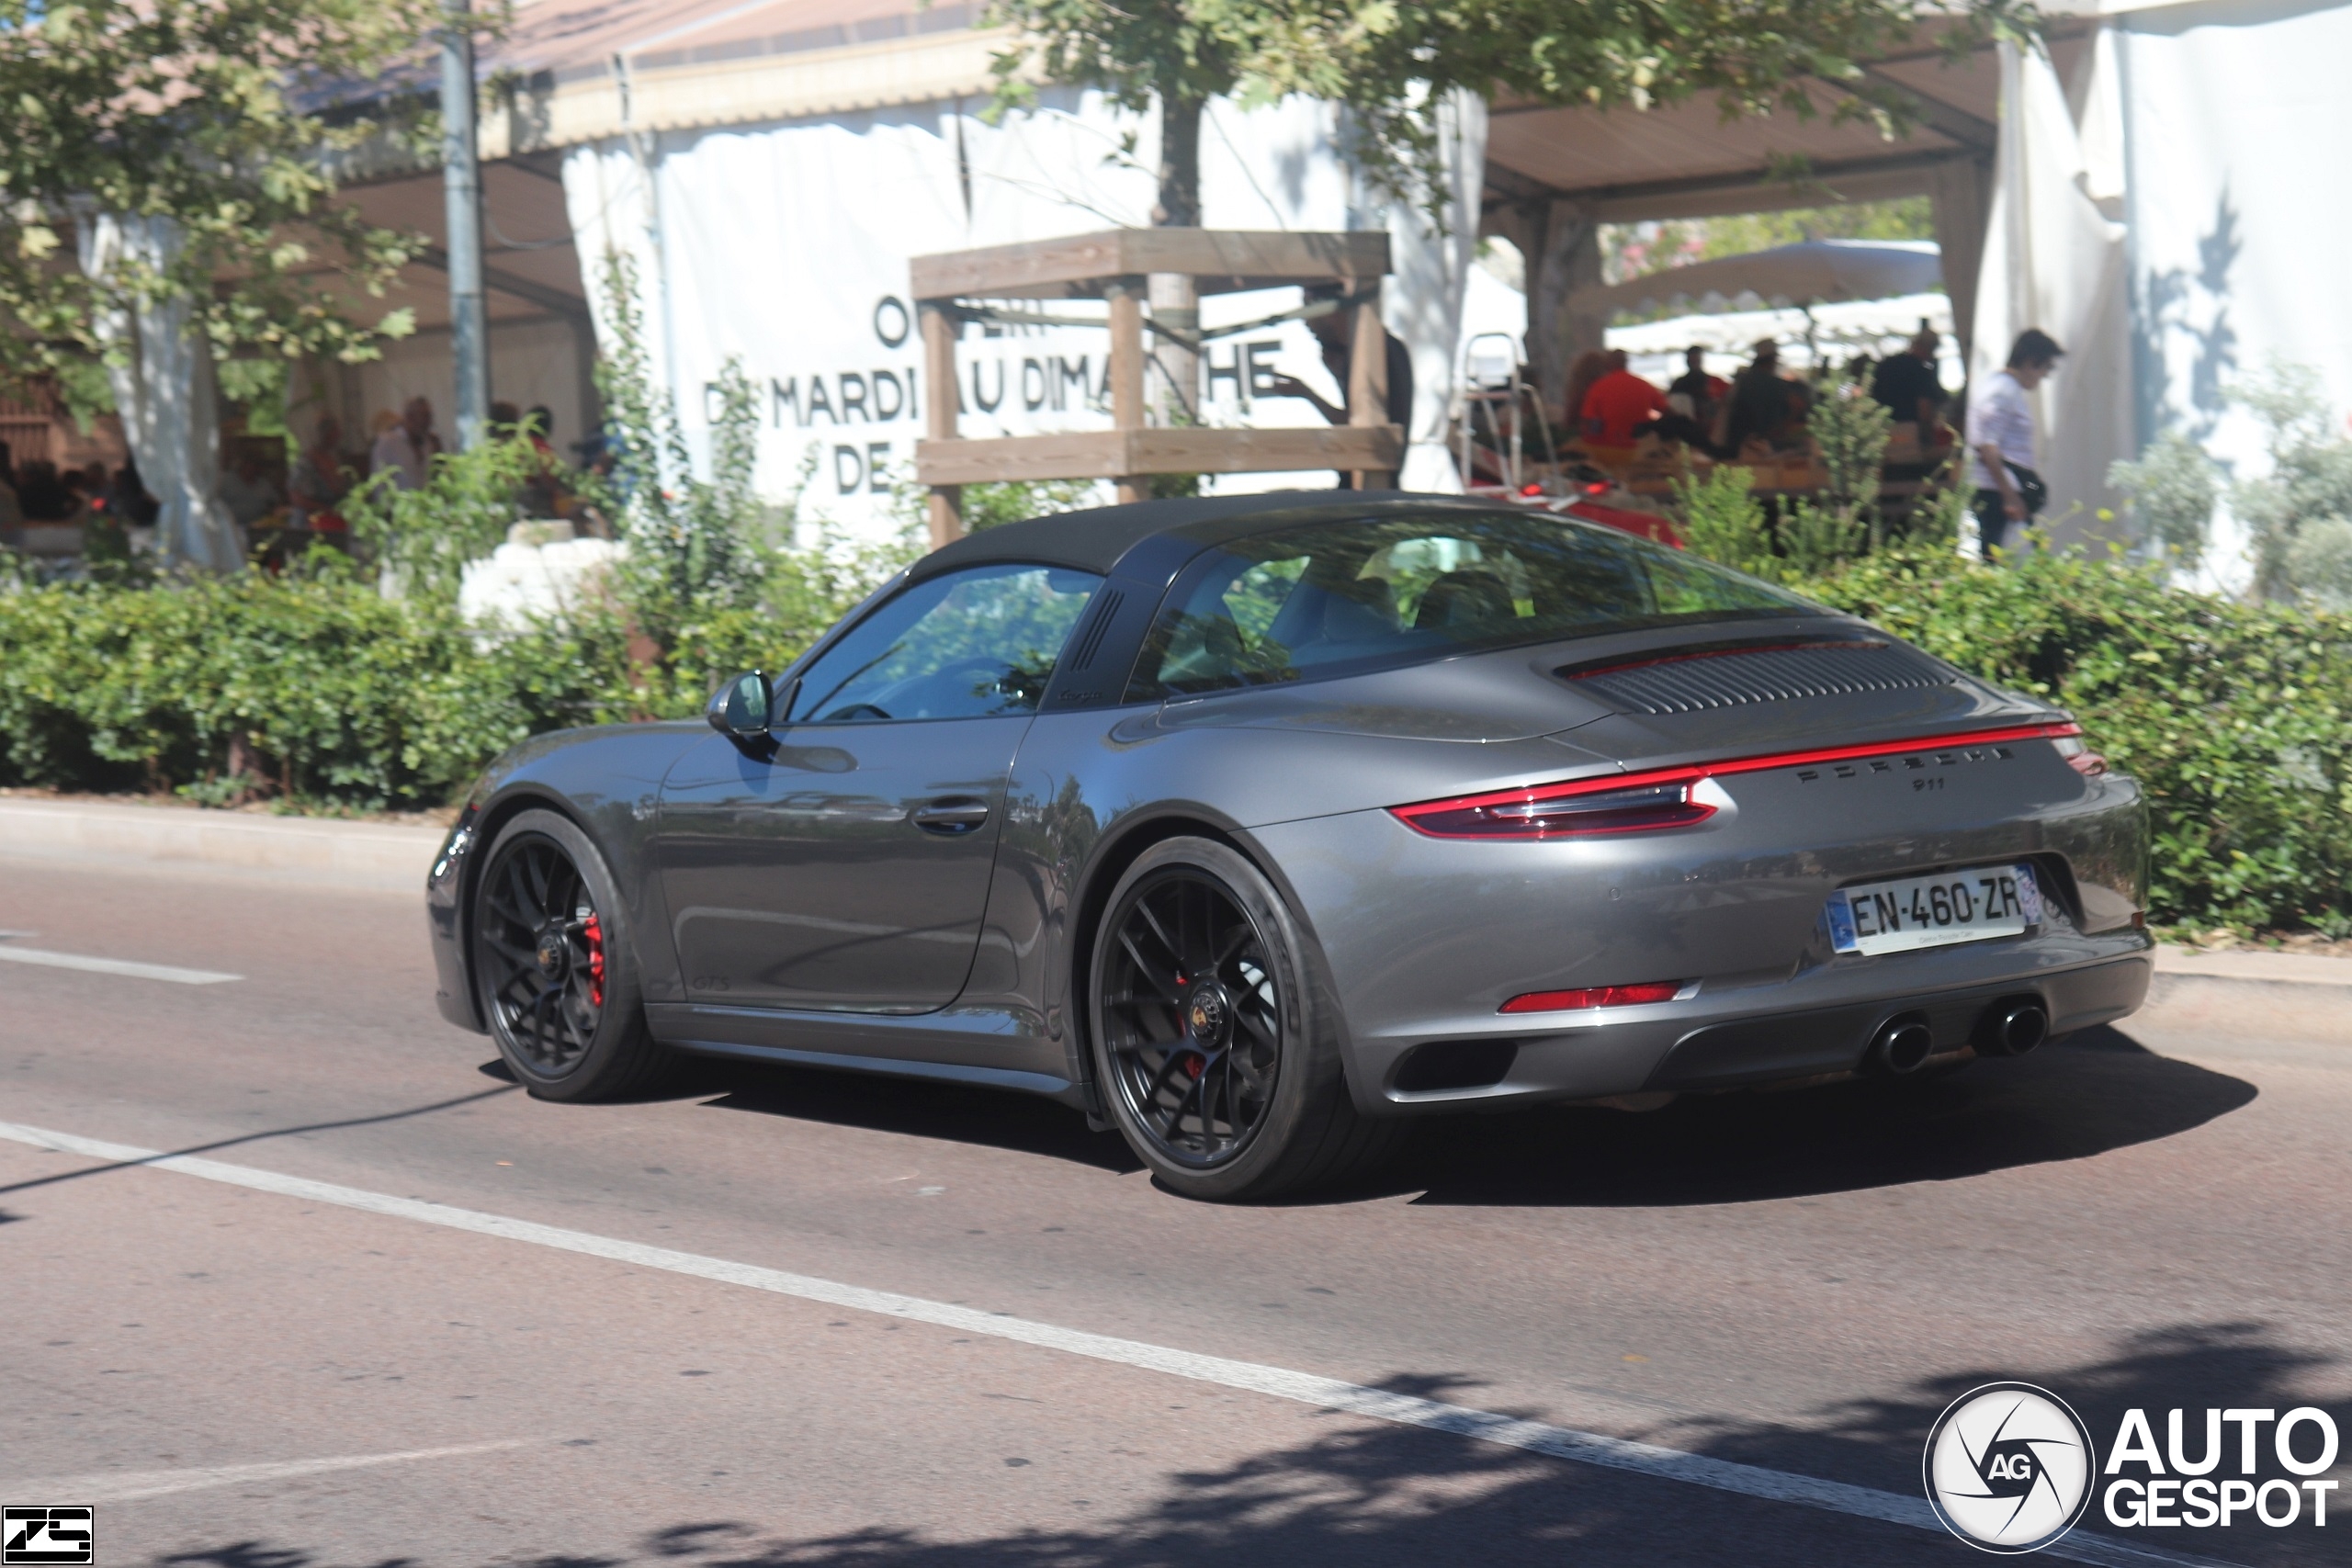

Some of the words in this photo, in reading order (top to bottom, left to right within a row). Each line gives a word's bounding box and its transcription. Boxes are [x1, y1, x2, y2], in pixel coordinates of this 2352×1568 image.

[772, 366, 918, 429] MARDI
[1021, 340, 1283, 413] DIMHE
[834, 441, 891, 496] DE
[1796, 746, 2015, 784] PORSCHE
[1912, 777, 1946, 792] 911
[1849, 875, 2022, 939] EN-460-ZR
[693, 975, 729, 992] GTS
